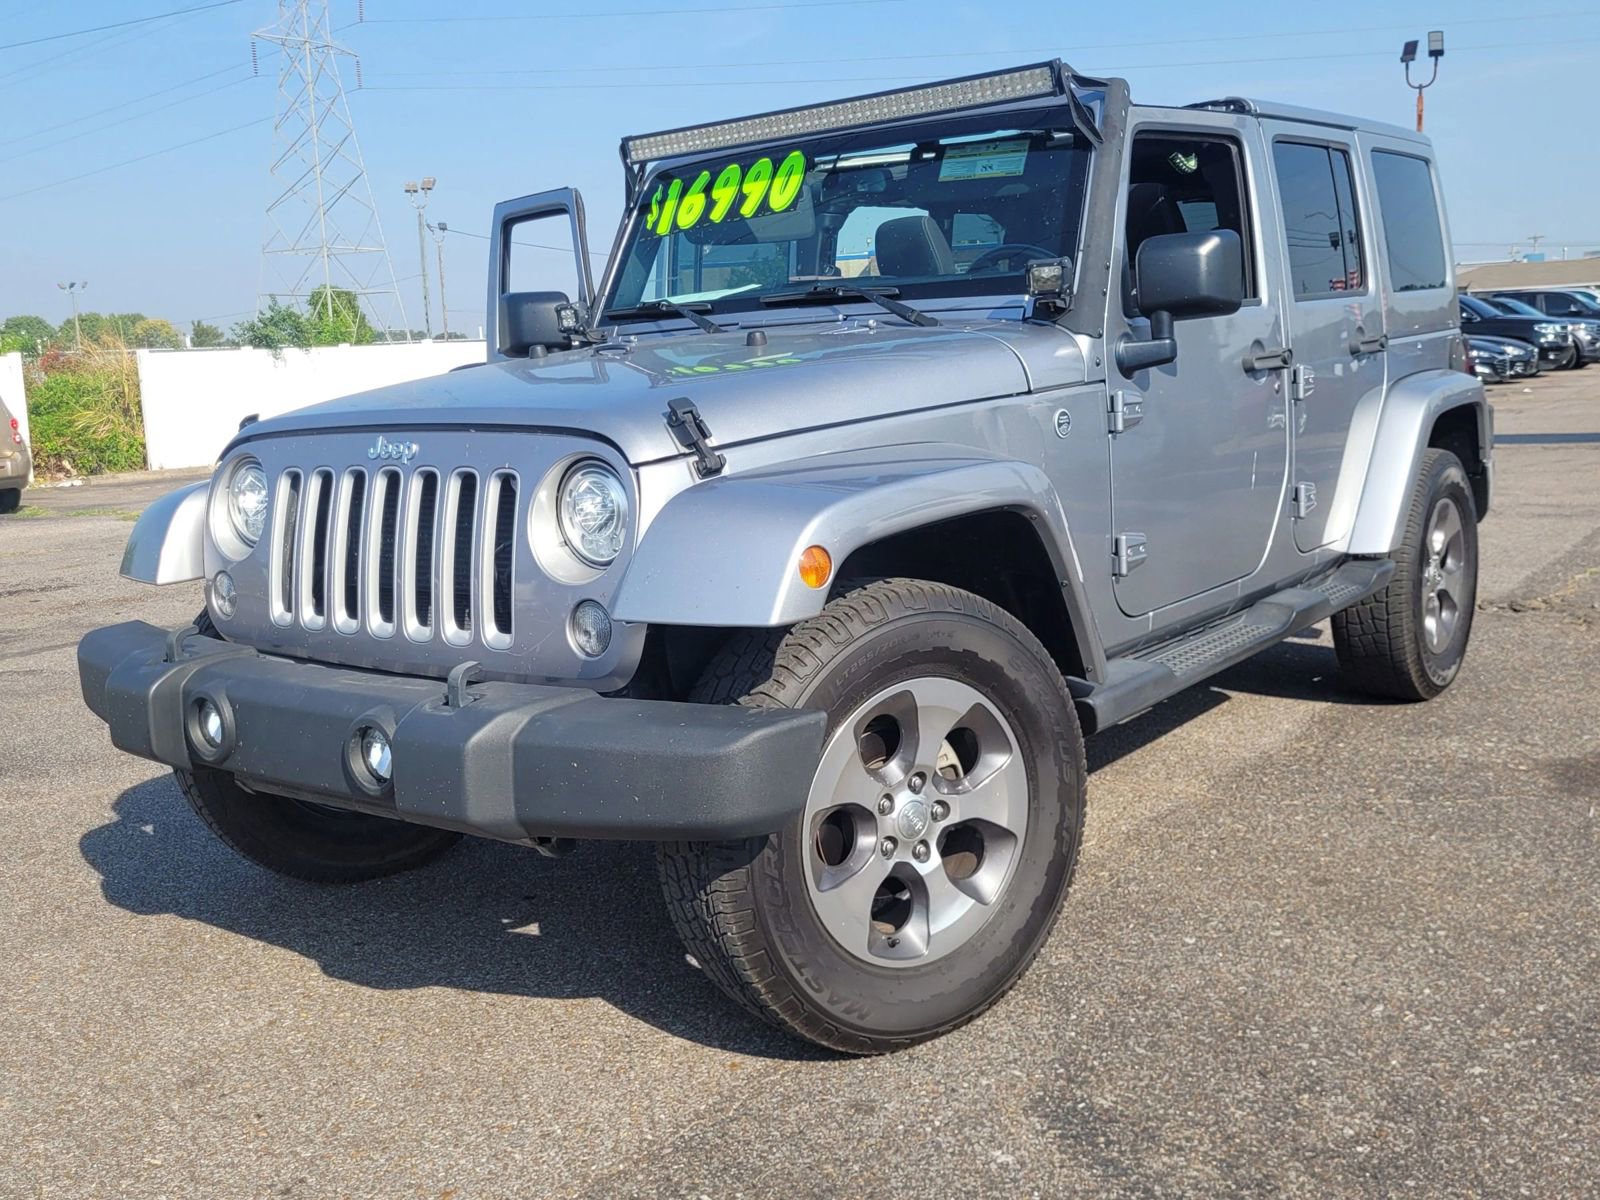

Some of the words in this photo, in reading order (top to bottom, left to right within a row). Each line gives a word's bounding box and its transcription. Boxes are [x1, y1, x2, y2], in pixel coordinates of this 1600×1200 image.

[646, 150, 806, 236] $16990
[368, 435, 418, 464] Jeep
[904, 809, 924, 832] Jeep
